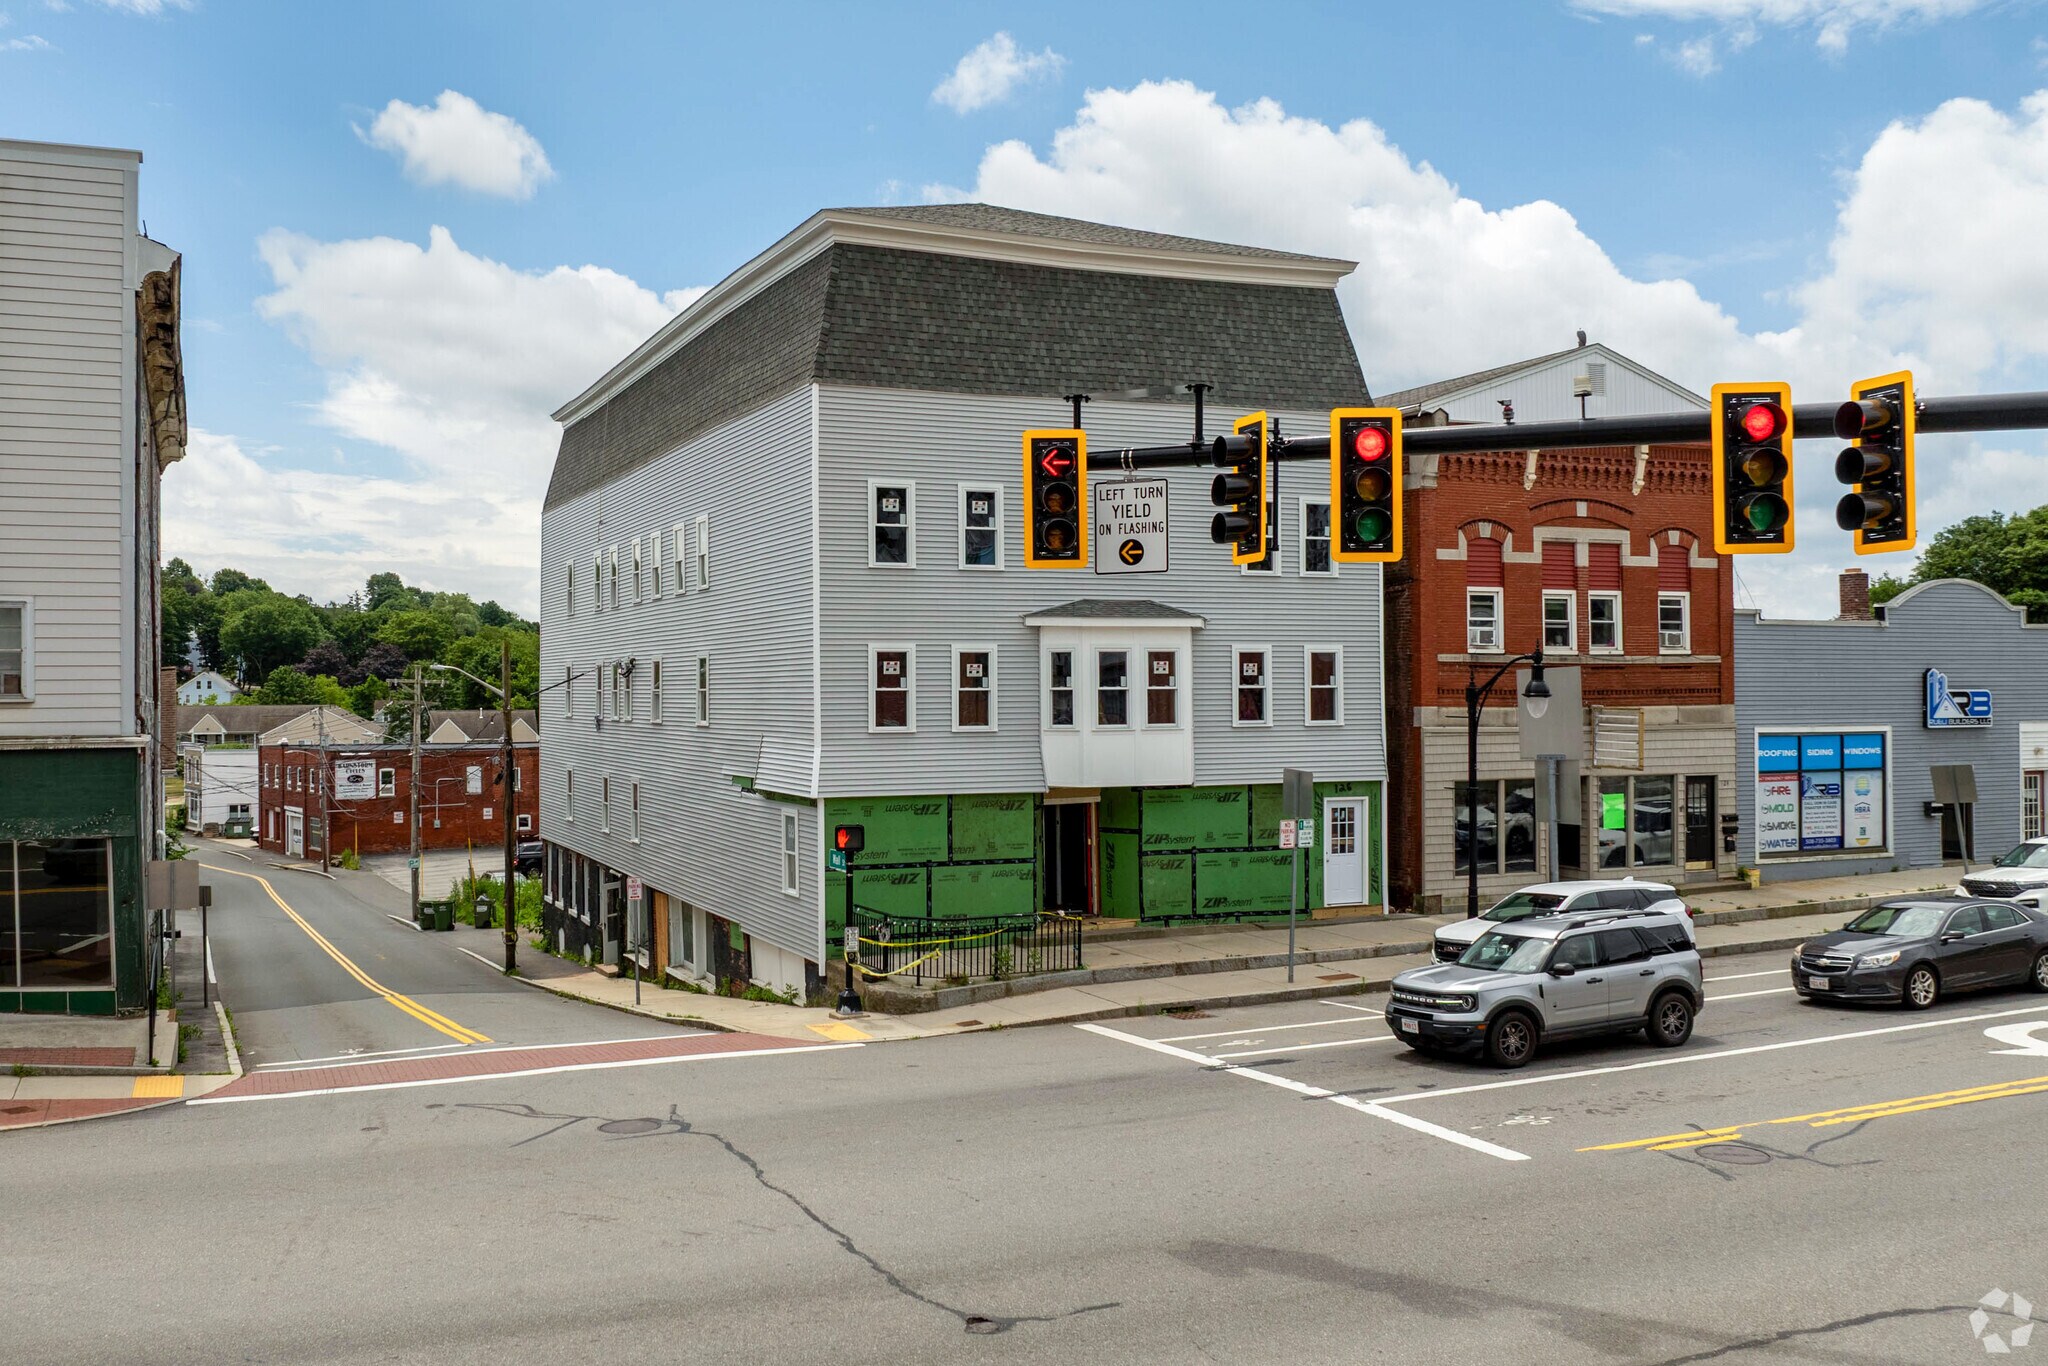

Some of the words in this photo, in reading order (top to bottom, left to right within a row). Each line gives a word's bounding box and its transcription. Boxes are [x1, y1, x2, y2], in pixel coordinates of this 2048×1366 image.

[1099, 488, 1125, 501] LEFT
[1134, 486, 1163, 499] TURN
[1112, 503, 1151, 519] YIELD
[1099, 524, 1112, 536] ON
[1118, 521, 1164, 535] FLASHING
[1758, 749, 1798, 757] ROOFING
[1334, 783, 1352, 793] 126
[1771, 786, 1791, 795] FIRE
[1769, 803, 1794, 813] MOLD
[1767, 821, 1796, 831] SMOKE
[1767, 839, 1797, 848] WATER
[1395, 993, 1434, 1003] BRONCO
